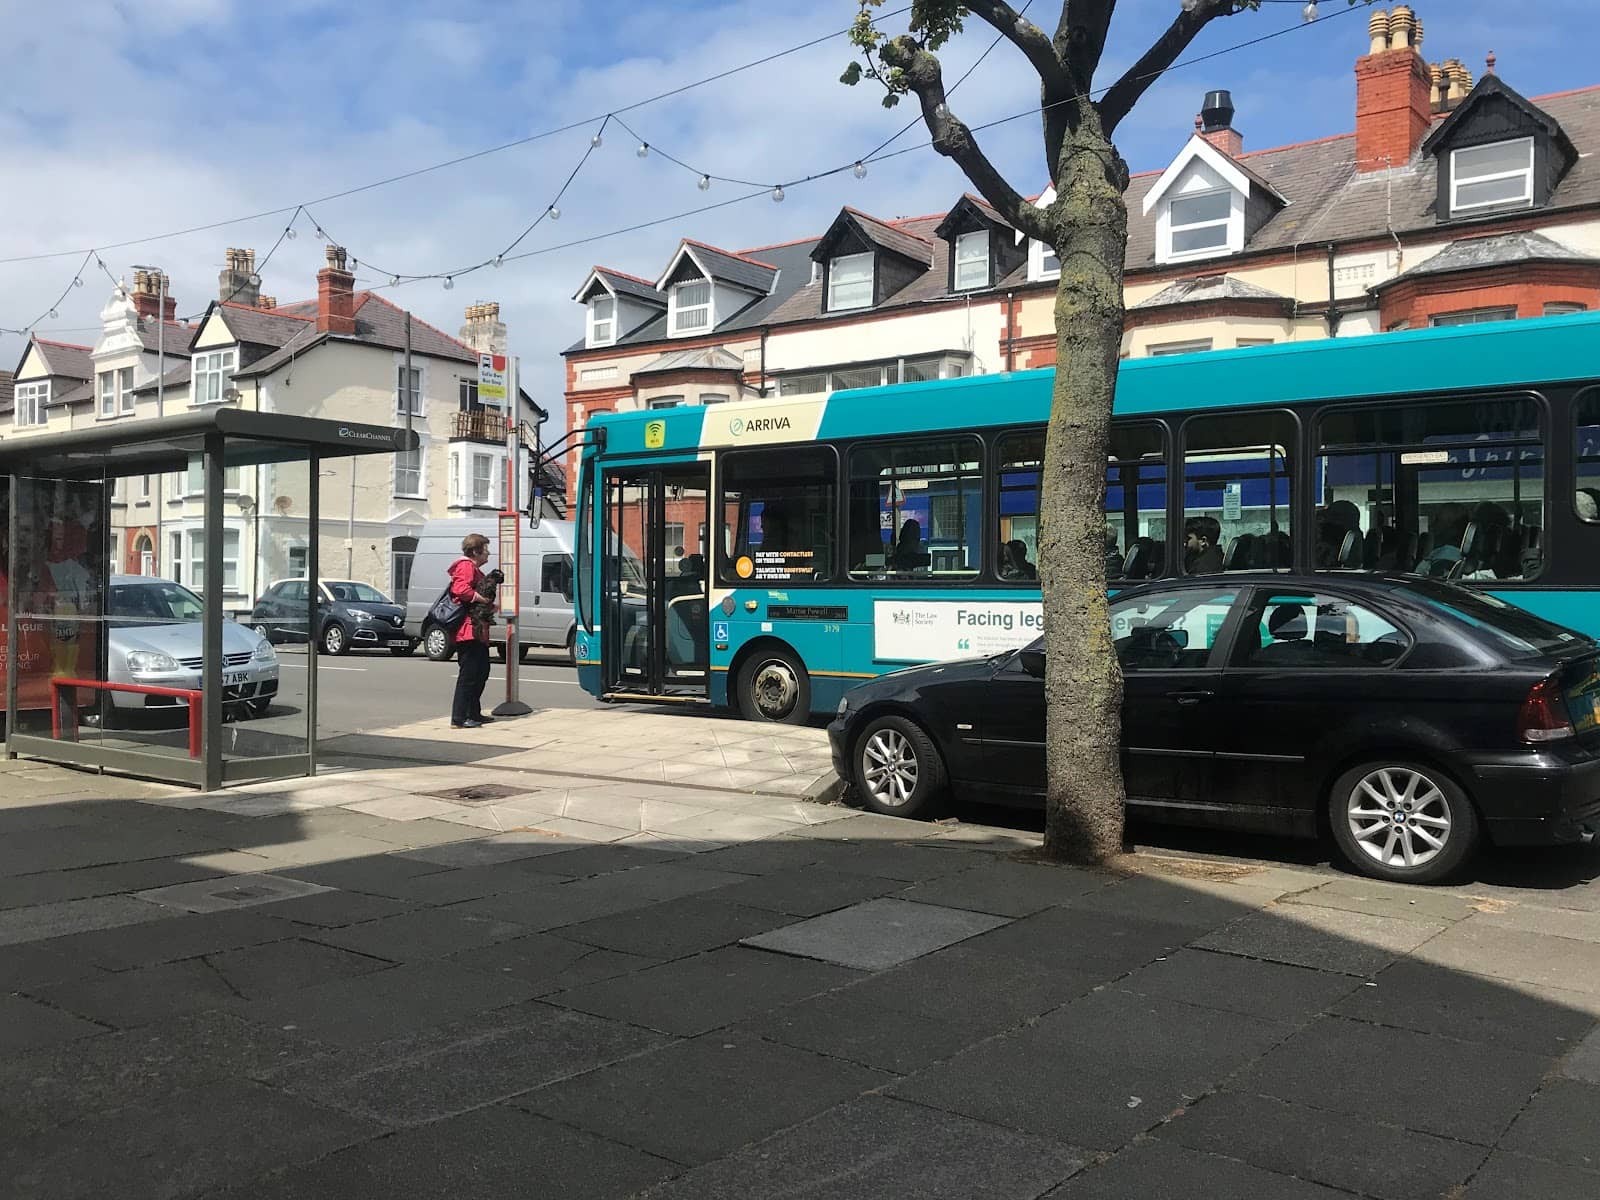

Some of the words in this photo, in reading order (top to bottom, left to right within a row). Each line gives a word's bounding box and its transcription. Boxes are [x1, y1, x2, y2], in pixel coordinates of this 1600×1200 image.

[745, 416, 791, 432] ARRIVA
[957, 609, 1014, 631] Facing
[1019, 610, 1045, 631] leg
[1, 623, 44, 632] LGUE
[232, 672, 249, 684] ABK
